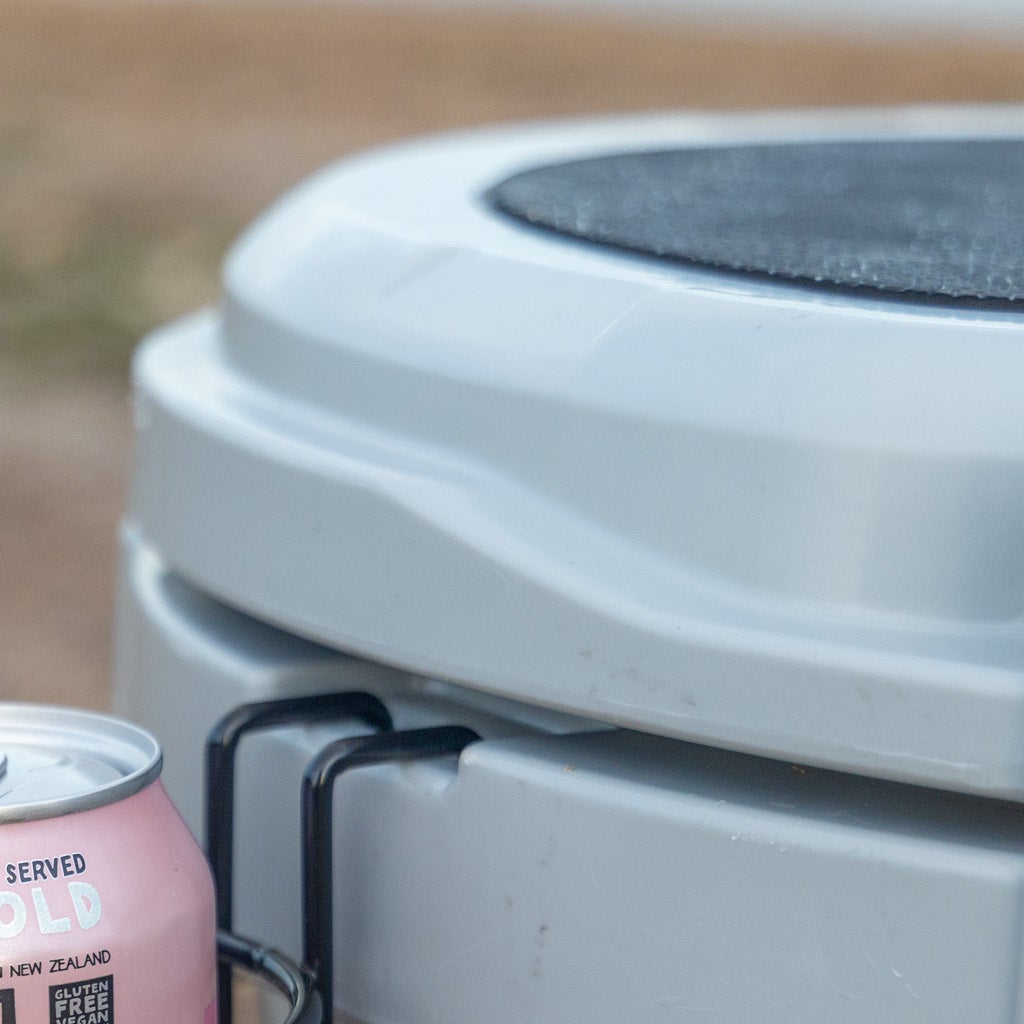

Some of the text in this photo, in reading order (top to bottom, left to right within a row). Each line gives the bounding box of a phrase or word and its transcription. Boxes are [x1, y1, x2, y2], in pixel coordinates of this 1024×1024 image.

[6, 853, 87, 884] SERVED
[10, 962, 42, 978] NEW
[49, 950, 111, 973] ZEALAND
[55, 980, 109, 1000] GLUTEN
[55, 992, 109, 1018] FREE
